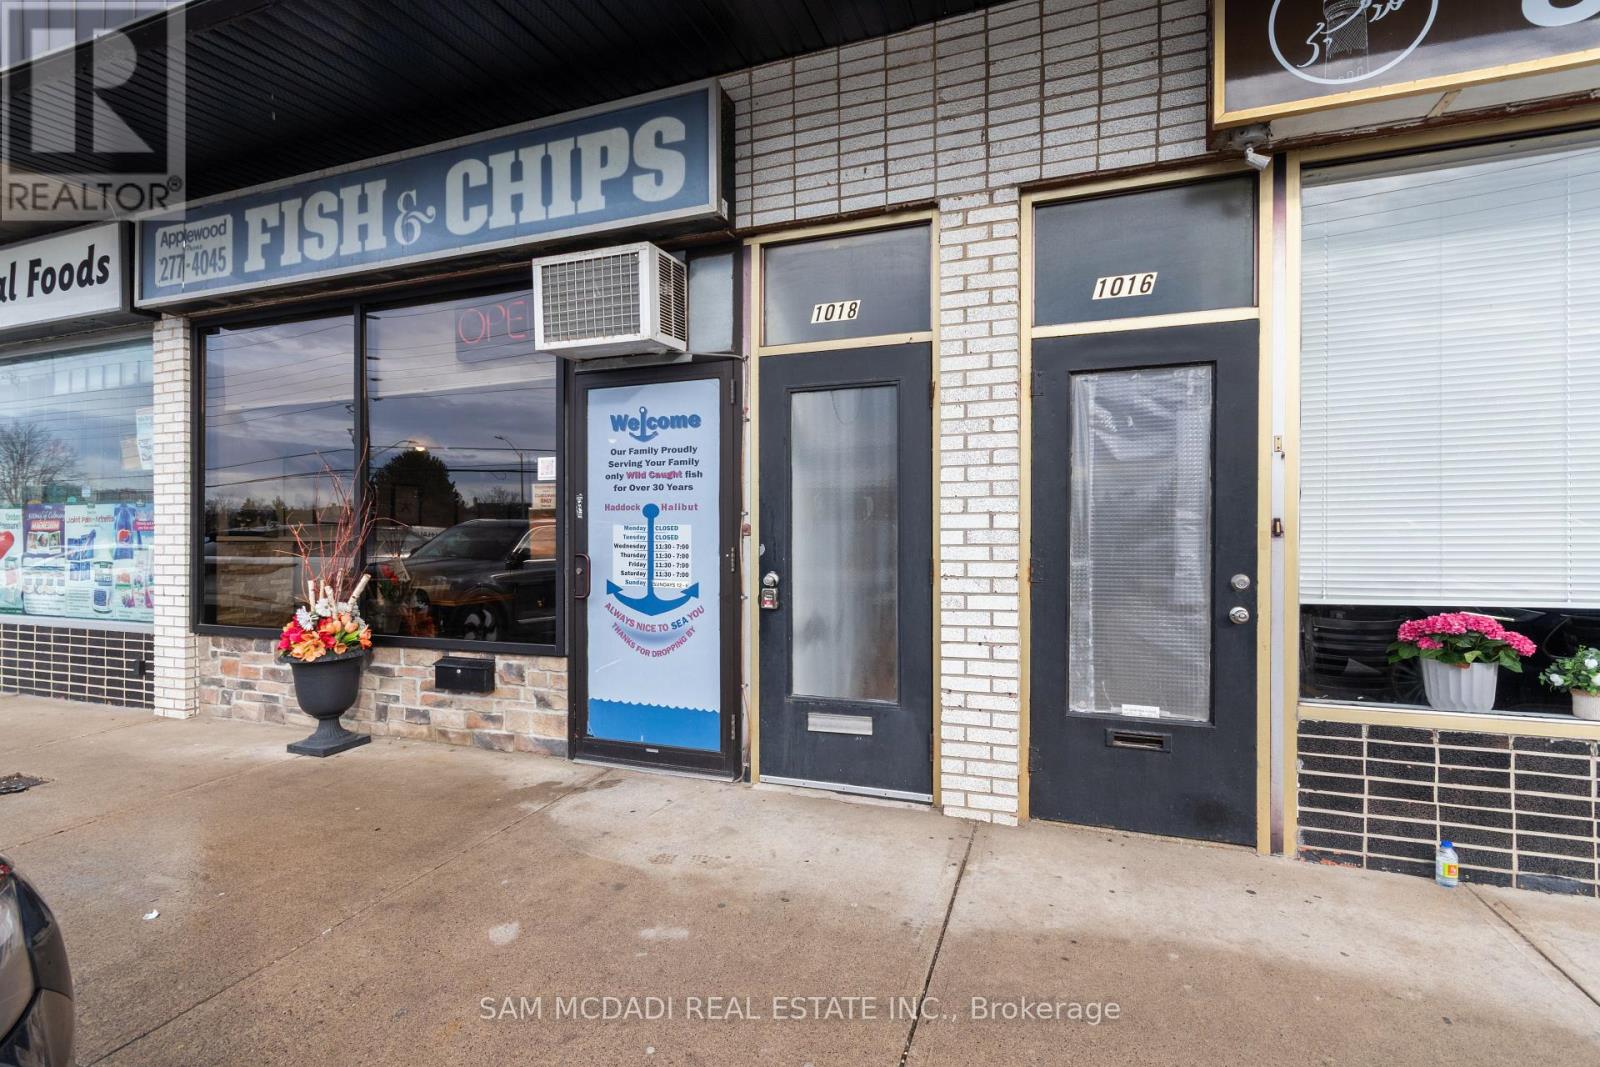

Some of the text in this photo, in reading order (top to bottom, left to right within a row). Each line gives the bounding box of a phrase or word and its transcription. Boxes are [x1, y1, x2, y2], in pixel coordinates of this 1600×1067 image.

[244, 115, 687, 273] FISH & CHIPS
[160, 219, 227, 248] Applewood
[26, 244, 111, 298] Foods
[160, 246, 227, 282] 277-4045
[1099, 273, 1154, 298] 1016
[458, 300, 532, 343] OPE
[815, 302, 858, 322] 1018
[610, 407, 702, 438] Welcome
[608, 457, 700, 469] Serving Your Family
[610, 445, 698, 456] Our Family Proudly
[605, 470, 703, 482] only Wild Caught fish
[613, 484, 627, 492] for
[629, 484, 650, 492] Over
[667, 483, 694, 491] Years
[604, 503, 641, 512] Haddock
[661, 503, 699, 511] Halibut
[604, 602, 635, 627] ALWAYS
[636, 624, 656, 633] NICE
[671, 617, 689, 630] SEA
[687, 605, 705, 620] YOU
[611, 622, 696, 658] THANKS FOR DROPPING BY
